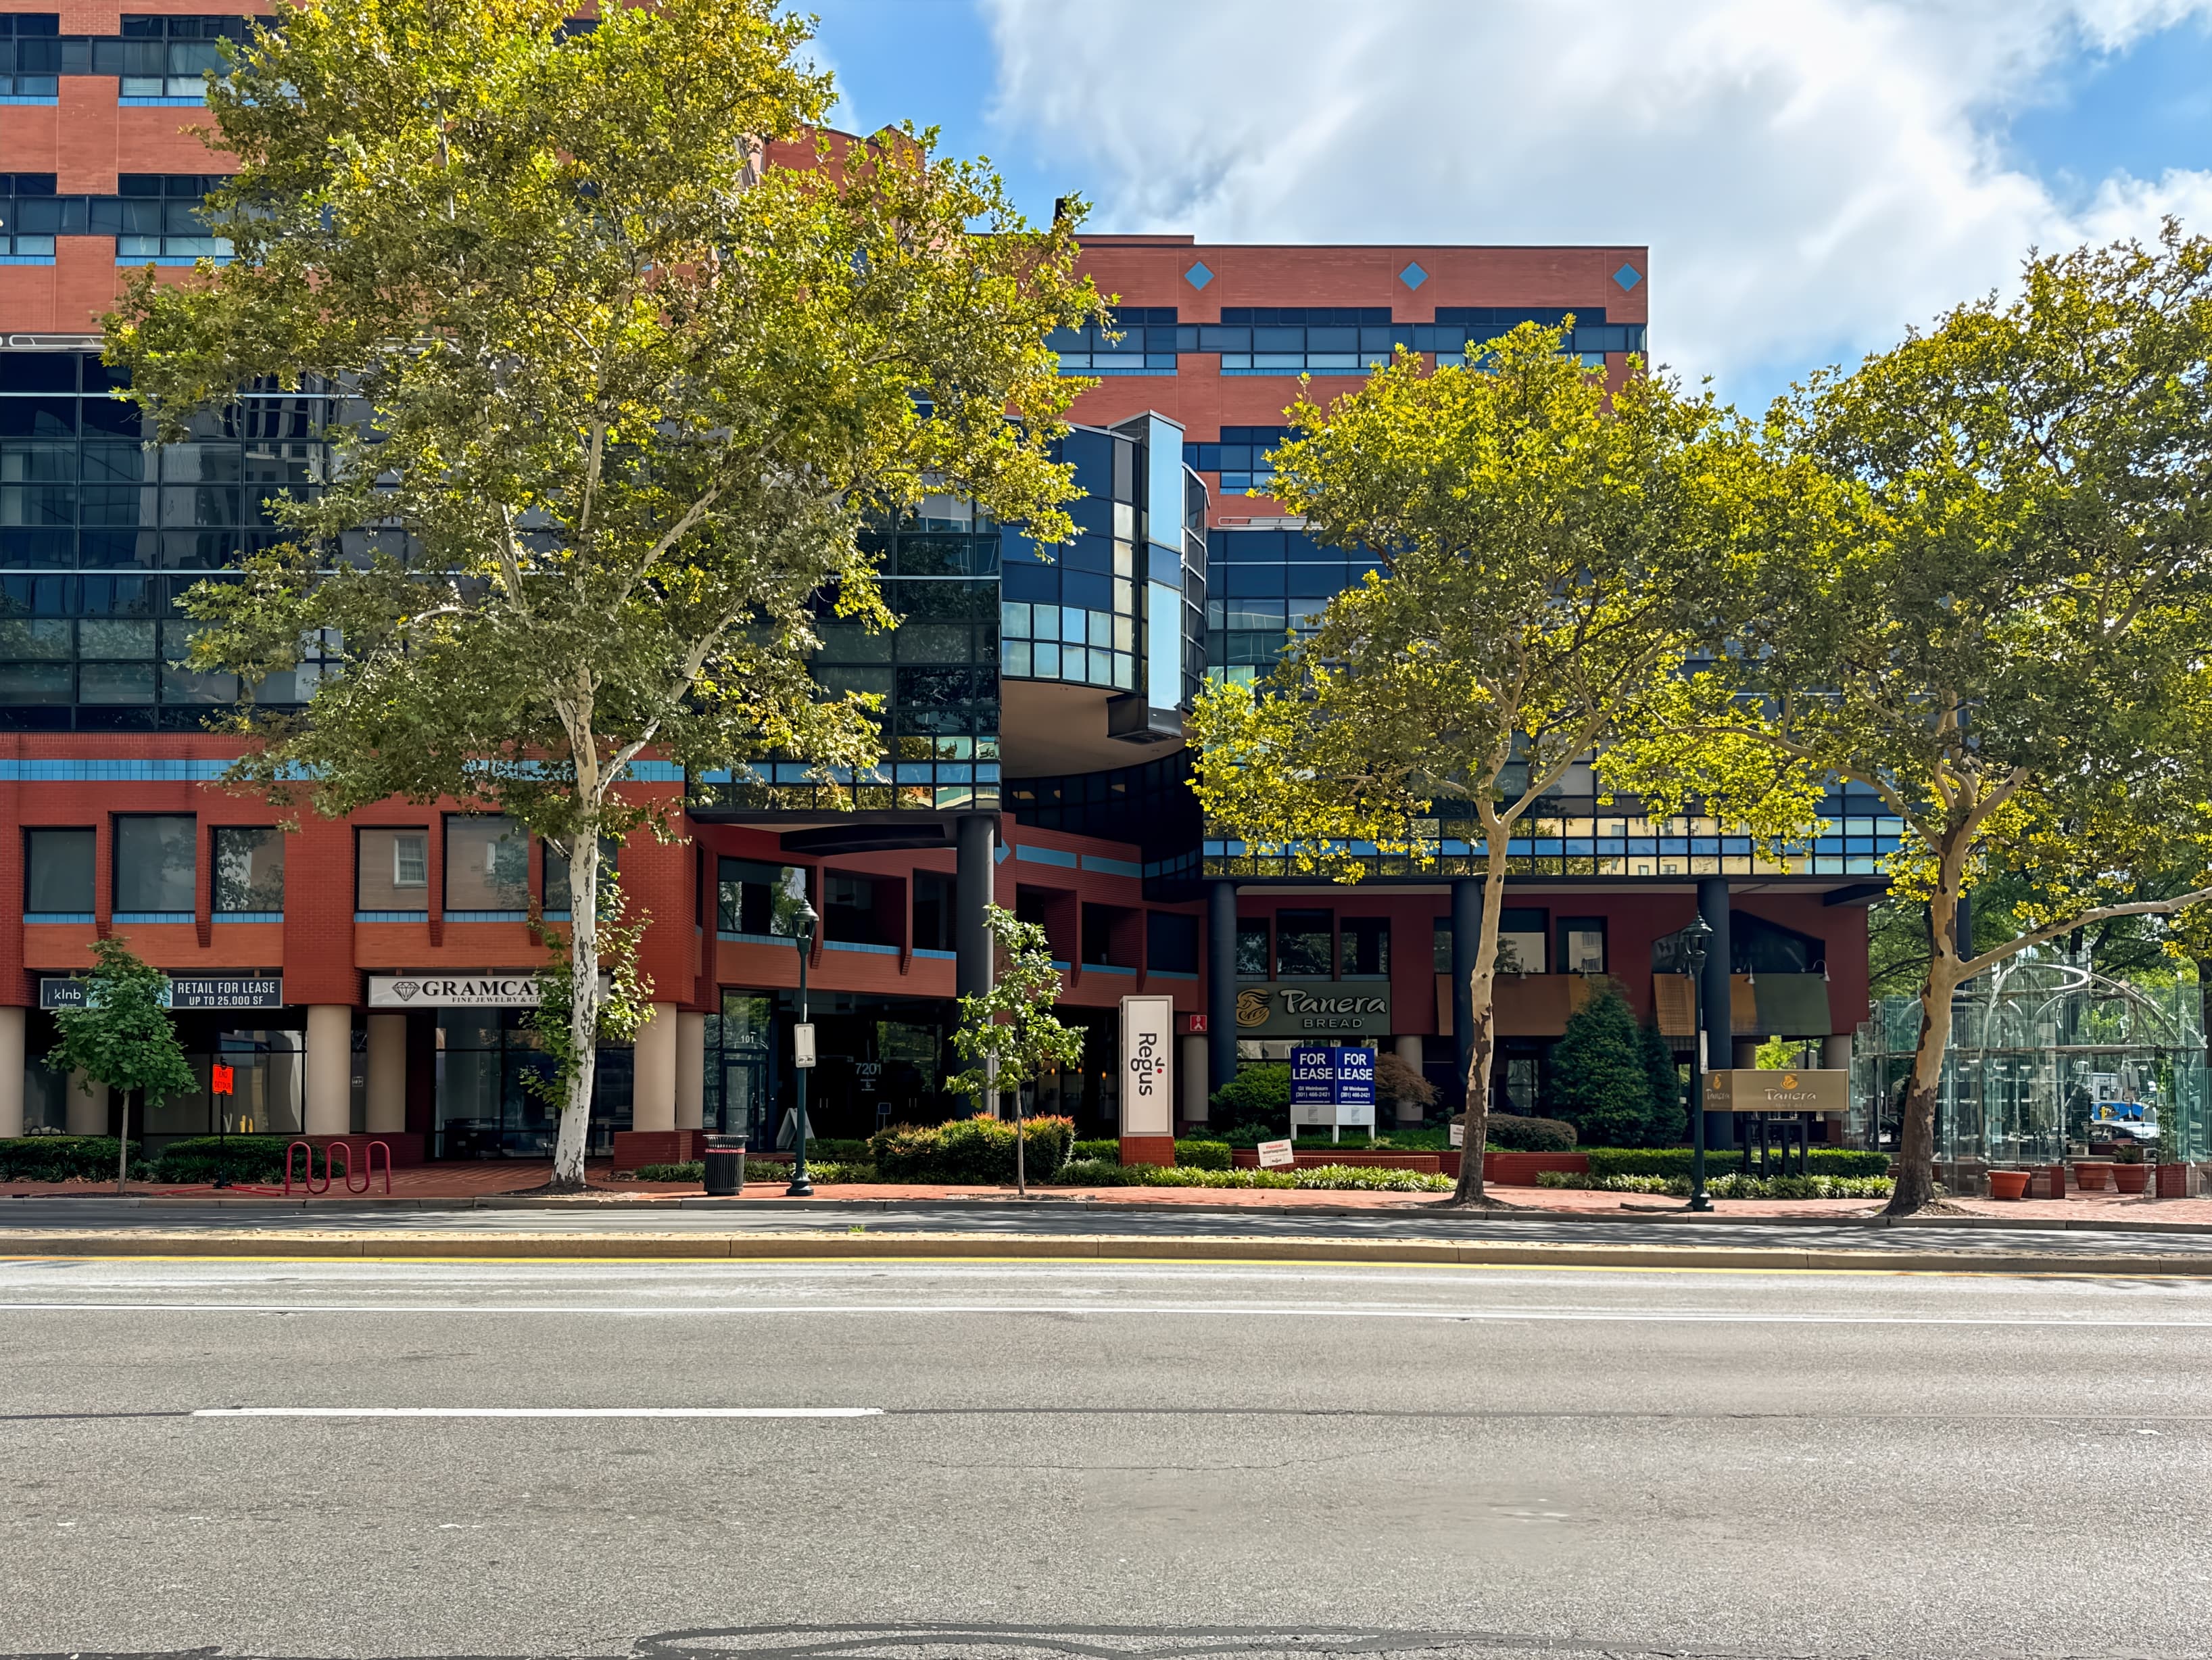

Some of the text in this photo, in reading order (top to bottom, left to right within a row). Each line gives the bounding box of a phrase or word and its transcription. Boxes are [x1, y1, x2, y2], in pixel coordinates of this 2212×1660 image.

[54, 988, 81, 999] klnb
[178, 982, 275, 994] RETAIL FOR LEASE
[189, 995, 263, 1005] UP TO 25,000 SF
[1280, 989, 1387, 1013] Panera
[1303, 1019, 1363, 1028] BREAD
[741, 1035, 754, 1043] 101
[1130, 1033, 1157, 1096] Regus
[1299, 1053, 1326, 1066] FOR
[1344, 1053, 1367, 1066] FOR
[855, 1063, 882, 1074] 7201
[1293, 1068, 1333, 1080] LEASE
[1338, 1068, 1373, 1081] LEASE
